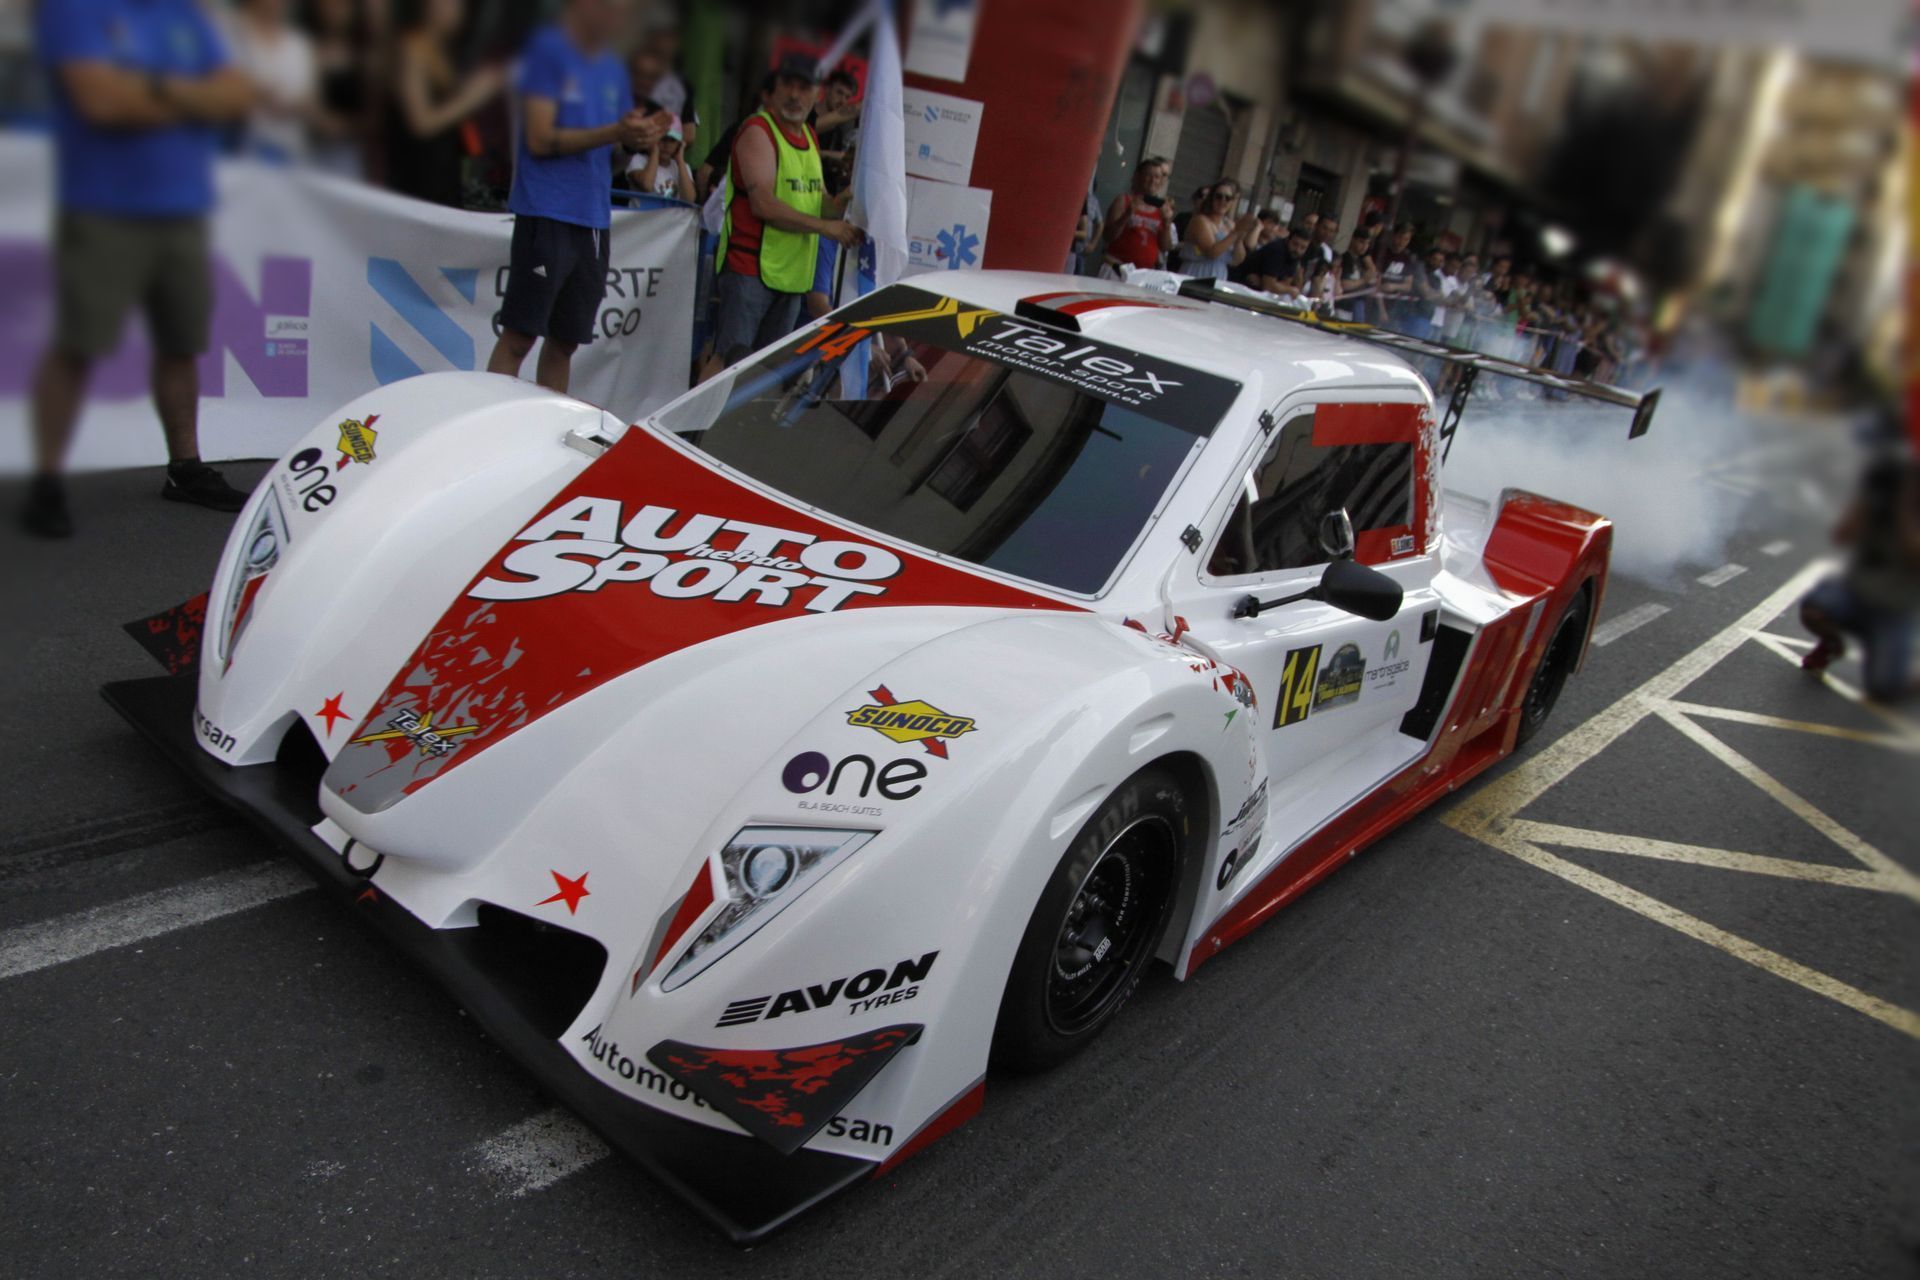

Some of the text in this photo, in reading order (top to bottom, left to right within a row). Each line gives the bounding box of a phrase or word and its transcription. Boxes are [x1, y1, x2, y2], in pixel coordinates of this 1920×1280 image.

[495, 265, 663, 298] DRTE
[795, 321, 872, 362] 14
[991, 321, 1183, 394] Talex
[966, 345, 1141, 405] www.talexmotorsport.es
[977, 339, 1157, 401] motor sport
[289, 447, 337, 512] one
[514, 495, 902, 581] AUTO
[685, 544, 803, 570] hebdo
[467, 538, 888, 612] SPORT
[1279, 647, 1319, 726] 14
[855, 709, 969, 735] SUNOCO
[782, 751, 928, 800] one
[819, 802, 850, 813] BEACH
[850, 804, 883, 816] SUITES
[763, 950, 941, 1019] AVON
[849, 985, 920, 1016] TYRES
[826, 1115, 894, 1146] san
